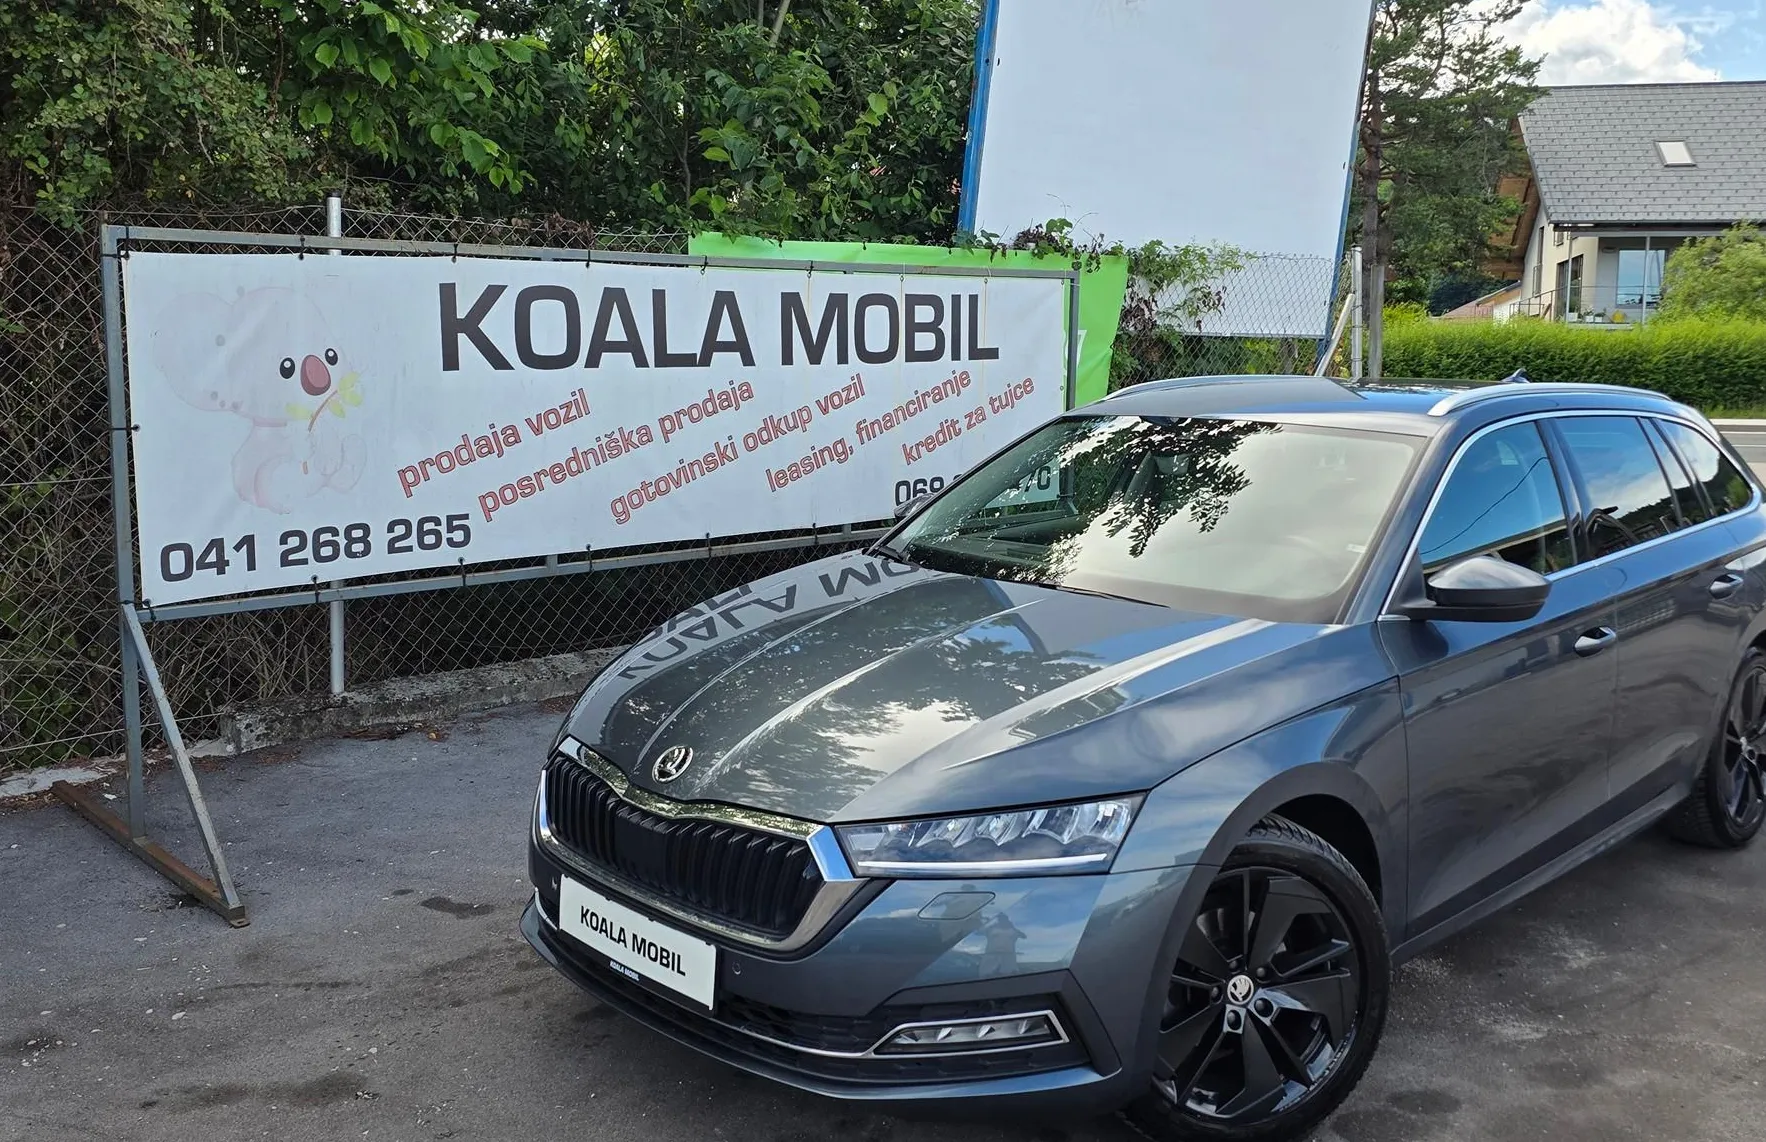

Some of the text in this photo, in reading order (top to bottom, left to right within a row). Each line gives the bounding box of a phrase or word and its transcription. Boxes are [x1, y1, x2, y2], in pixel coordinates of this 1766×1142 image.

[439, 282, 752, 371] KOALA
[781, 292, 999, 365] MOBIL
[397, 388, 590, 498] prodaja vozil
[478, 380, 754, 523] posredniška prodaja
[611, 373, 866, 525] gotovinski odkup vozil
[765, 370, 971, 492] leasing, financiranje
[902, 377, 1034, 466] kredit za tujce
[161, 513, 471, 582] 041 268 265
[581, 905, 686, 977] KOALA MOBIL
